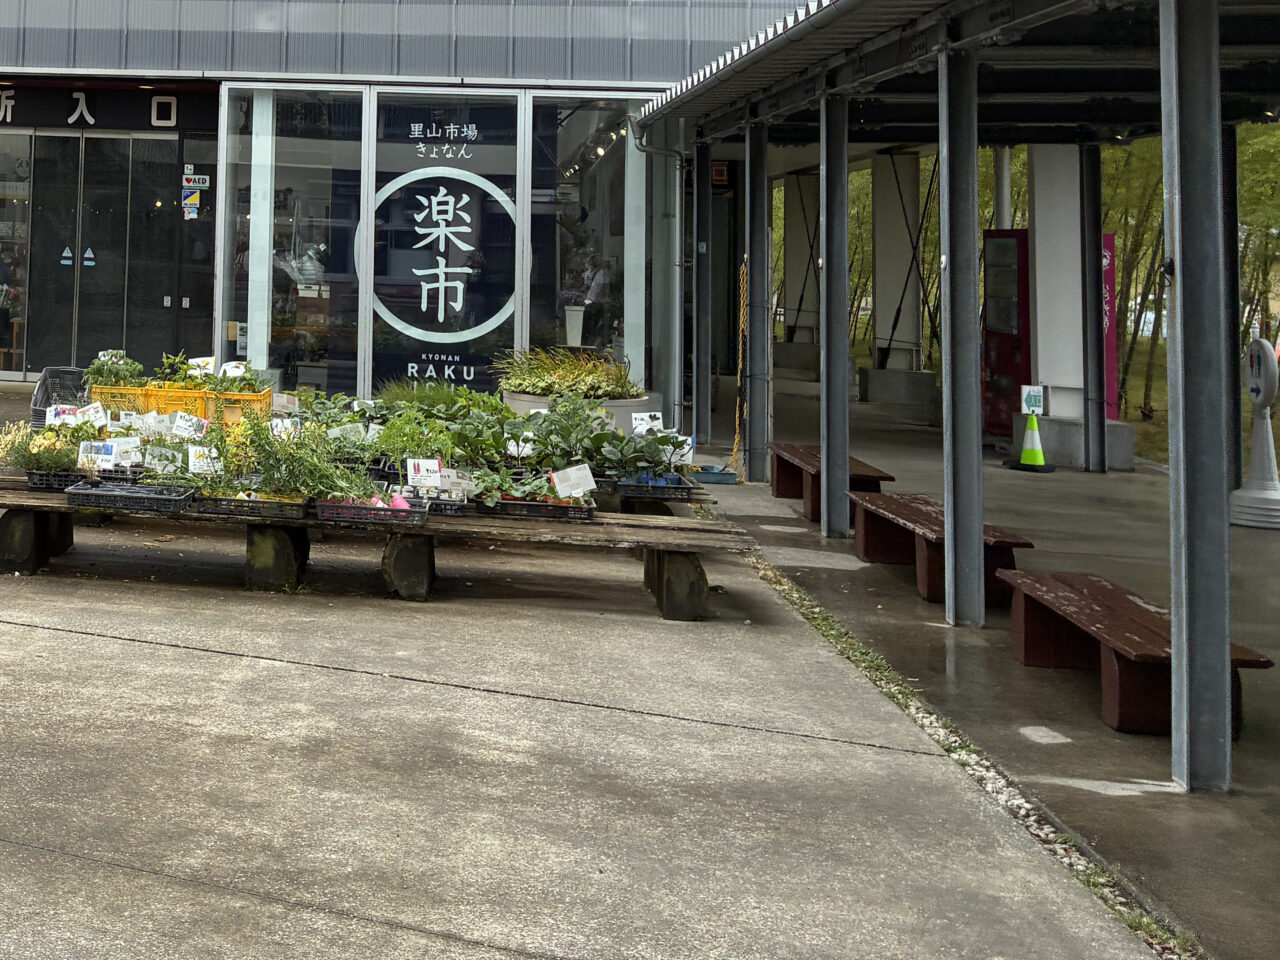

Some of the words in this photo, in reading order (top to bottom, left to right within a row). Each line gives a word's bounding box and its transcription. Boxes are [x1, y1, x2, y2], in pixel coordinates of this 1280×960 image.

[408, 123, 478, 141] 里山市場
[415, 141, 473, 159] きょなん
[192, 177, 207, 185] AED
[411, 186, 476, 323] 楽市
[421, 353, 460, 362] KYONAN
[407, 363, 475, 381] RAKU
